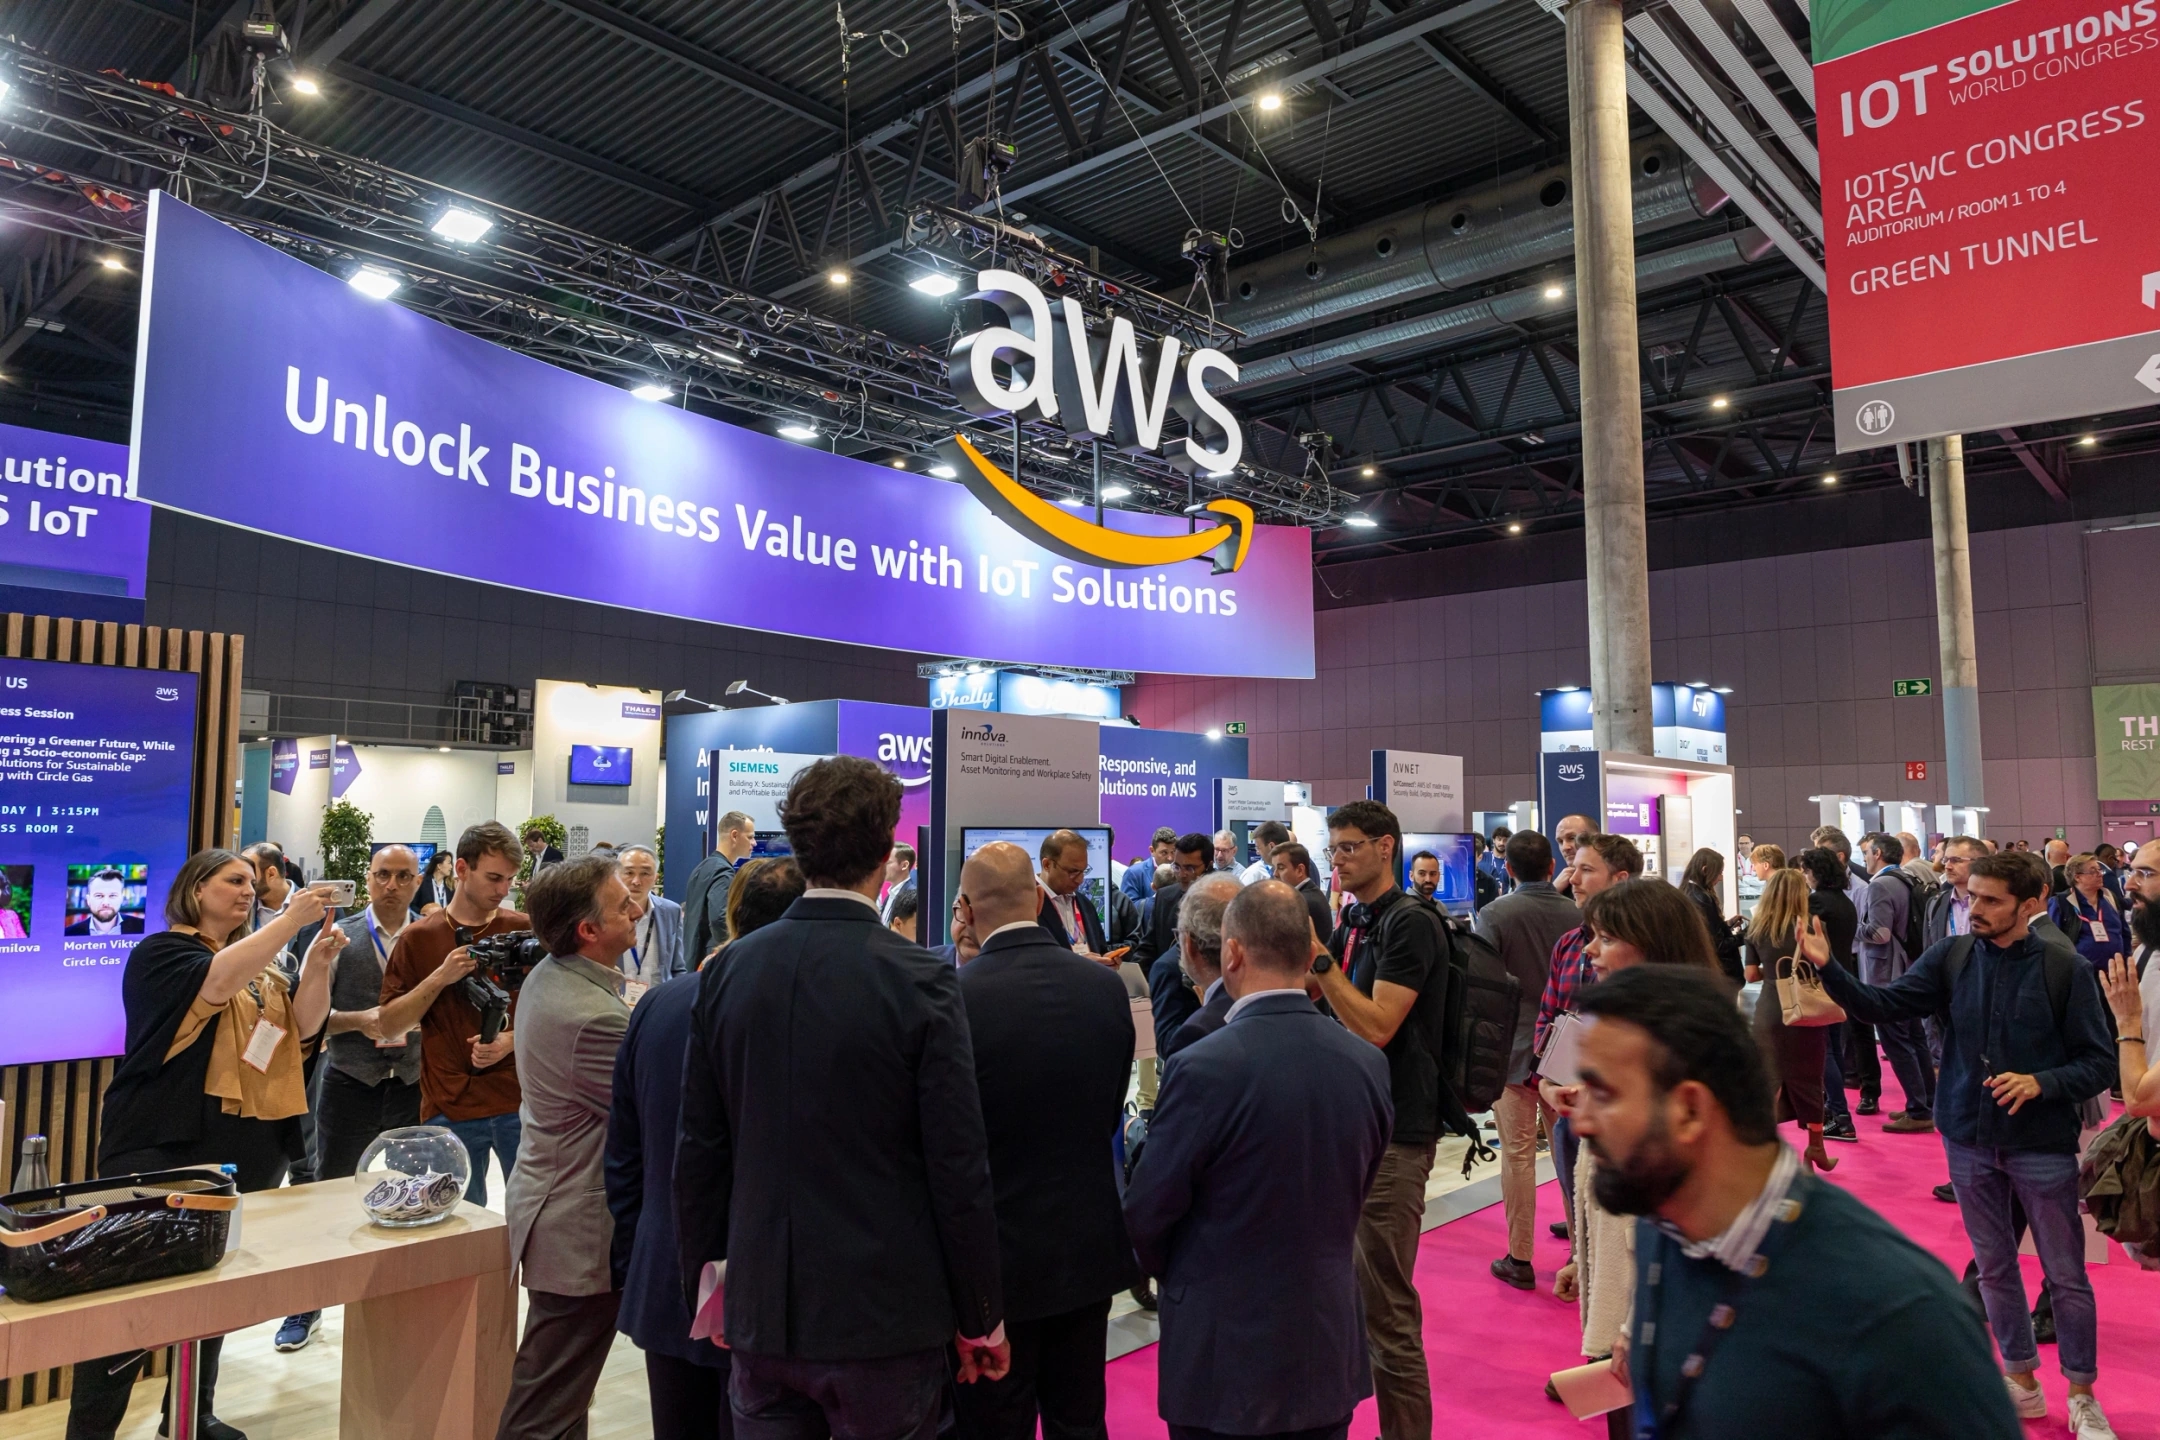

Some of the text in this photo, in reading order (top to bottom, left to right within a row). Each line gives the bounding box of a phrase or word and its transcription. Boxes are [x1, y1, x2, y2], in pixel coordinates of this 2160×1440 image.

[1839, 0, 2157, 138] IOT SOLUTIONS
[1948, 28, 2159, 106] WORLD CONGRESS
[1844, 100, 2146, 202] IOTSWC CONGRESS
[1845, 187, 1927, 229] AREA
[1846, 209, 1945, 247] AUDITORIUM
[1957, 196, 2008, 220] ROOM
[2012, 192, 2022, 206] 1
[2026, 184, 2051, 202] TO
[2054, 180, 2067, 195] 4
[1850, 219, 2098, 295] GREEN TUNNEL
[968, 269, 1243, 474] aws
[0, 456, 132, 500] ution
[286, 365, 1237, 616] Unlock Business Value with IoT Solutions
[29, 501, 98, 538] IoT
[6, 676, 28, 689] US
[155, 687, 178, 697] aws
[931, 685, 995, 709] Shelly
[0, 706, 74, 720] ess Session
[624, 705, 656, 714] THALES
[2119, 715, 2159, 737] TH
[961, 726, 1006, 743] innova
[38, 737, 46, 745] a
[49, 736, 97, 748] Greener
[99, 738, 140, 751] Future,
[143, 740, 175, 751] While
[878, 733, 932, 764] aws
[2121, 739, 2155, 751] REST
[13, 748, 20, 756] a
[23, 746, 117, 760] Socio-economic
[120, 751, 146, 763] Gap:
[960, 752, 983, 762] Smart
[985, 753, 1008, 765] Digital
[46, 759, 64, 770] for
[66, 760, 131, 772] Sustainable
[729, 761, 779, 774] SIEMENS
[960, 765, 1092, 782] Asset Monitoring and Workplace Safety
[1098, 754, 1196, 778] Responsive, and
[1393, 762, 1420, 774] AVNET
[1558, 763, 1584, 775] aws
[7, 770, 33, 781] with
[36, 771, 69, 782] Circle
[72, 772, 93, 783] Gas
[729, 780, 753, 789] Building
[742, 789, 770, 797] Profitable
[1151, 784, 1167, 797] on
[1169, 781, 1197, 798] AWS
[1, 805, 26, 815] DAY
[51, 806, 99, 816] 3:15PM
[25, 824, 58, 833] ROOM
[66, 824, 74, 834] 2
[64, 940, 106, 951] Morten
[63, 956, 121, 967] Circle Gas
